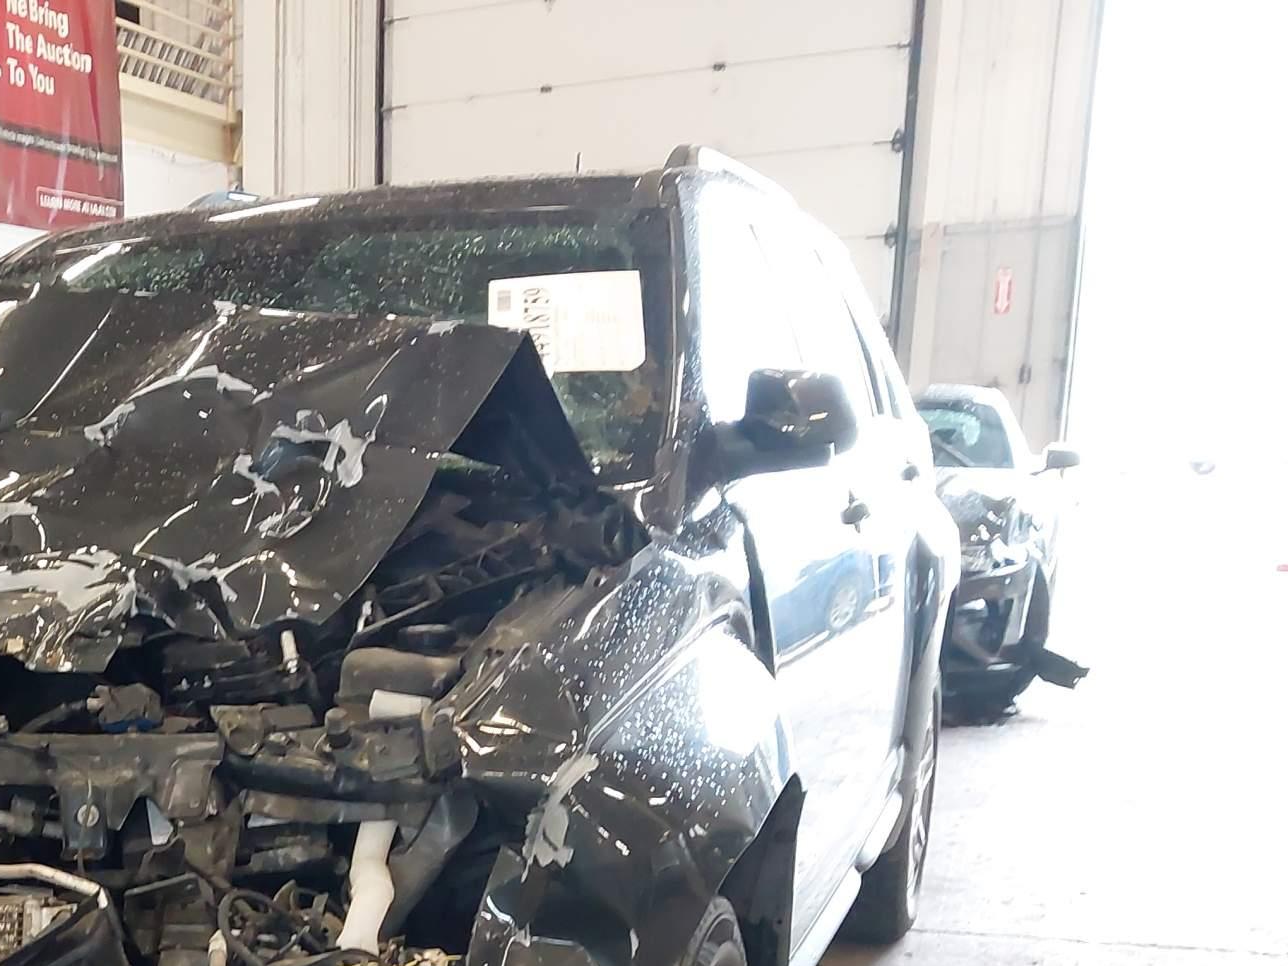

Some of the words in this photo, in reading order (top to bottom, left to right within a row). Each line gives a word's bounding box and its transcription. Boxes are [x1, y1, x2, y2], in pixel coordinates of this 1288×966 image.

[29, 0, 69, 38] Bring
[6, 21, 33, 55] The
[36, 33, 92, 74] Auction
[6, 56, 26, 88] To
[28, 63, 55, 96] You
